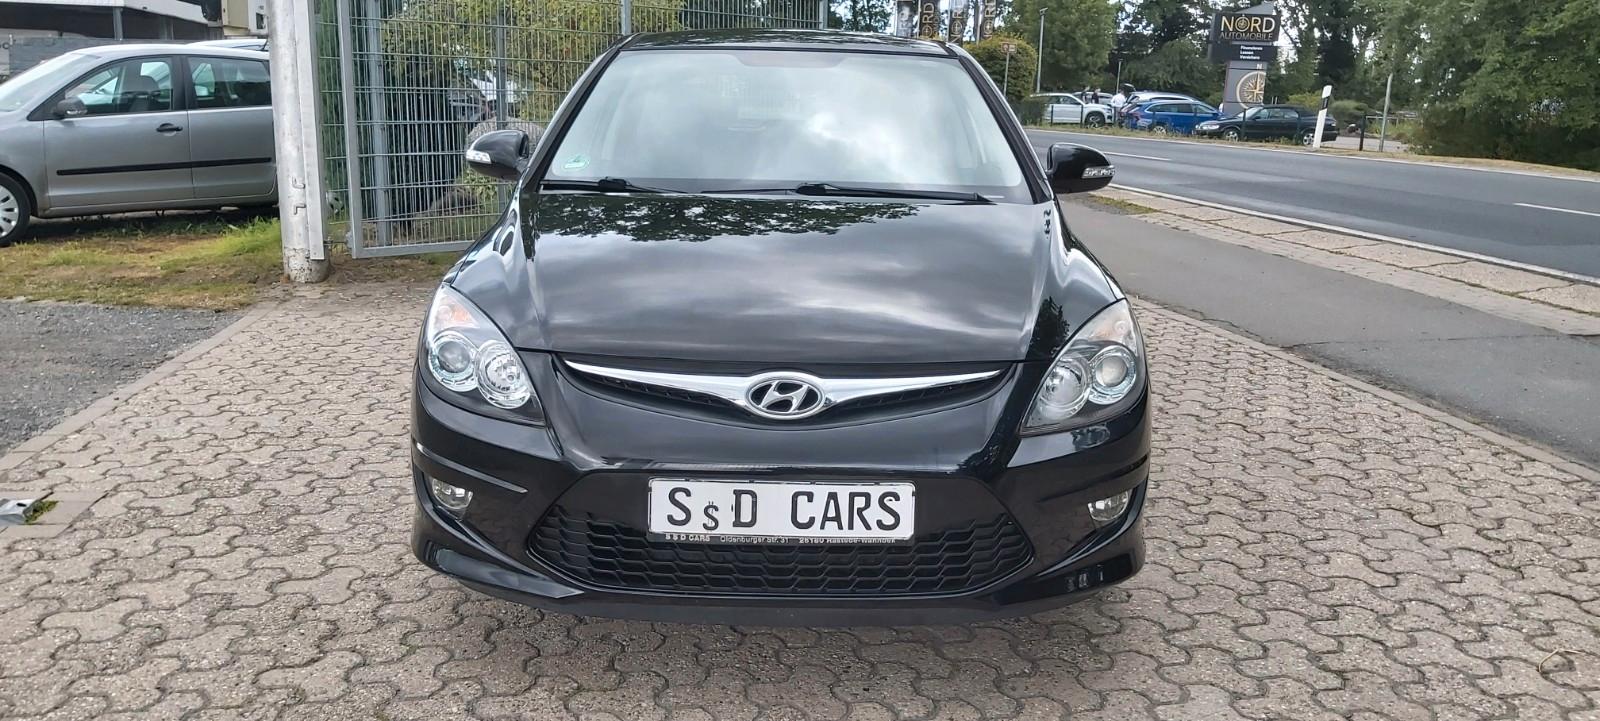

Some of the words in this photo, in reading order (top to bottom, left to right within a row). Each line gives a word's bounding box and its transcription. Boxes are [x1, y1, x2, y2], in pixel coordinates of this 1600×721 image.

[921, 2, 935, 39] ORD
[1220, 15, 1276, 33] NORD
[1219, 32, 1273, 41] AUTOMOBILE
[790, 490, 901, 531] CARS
